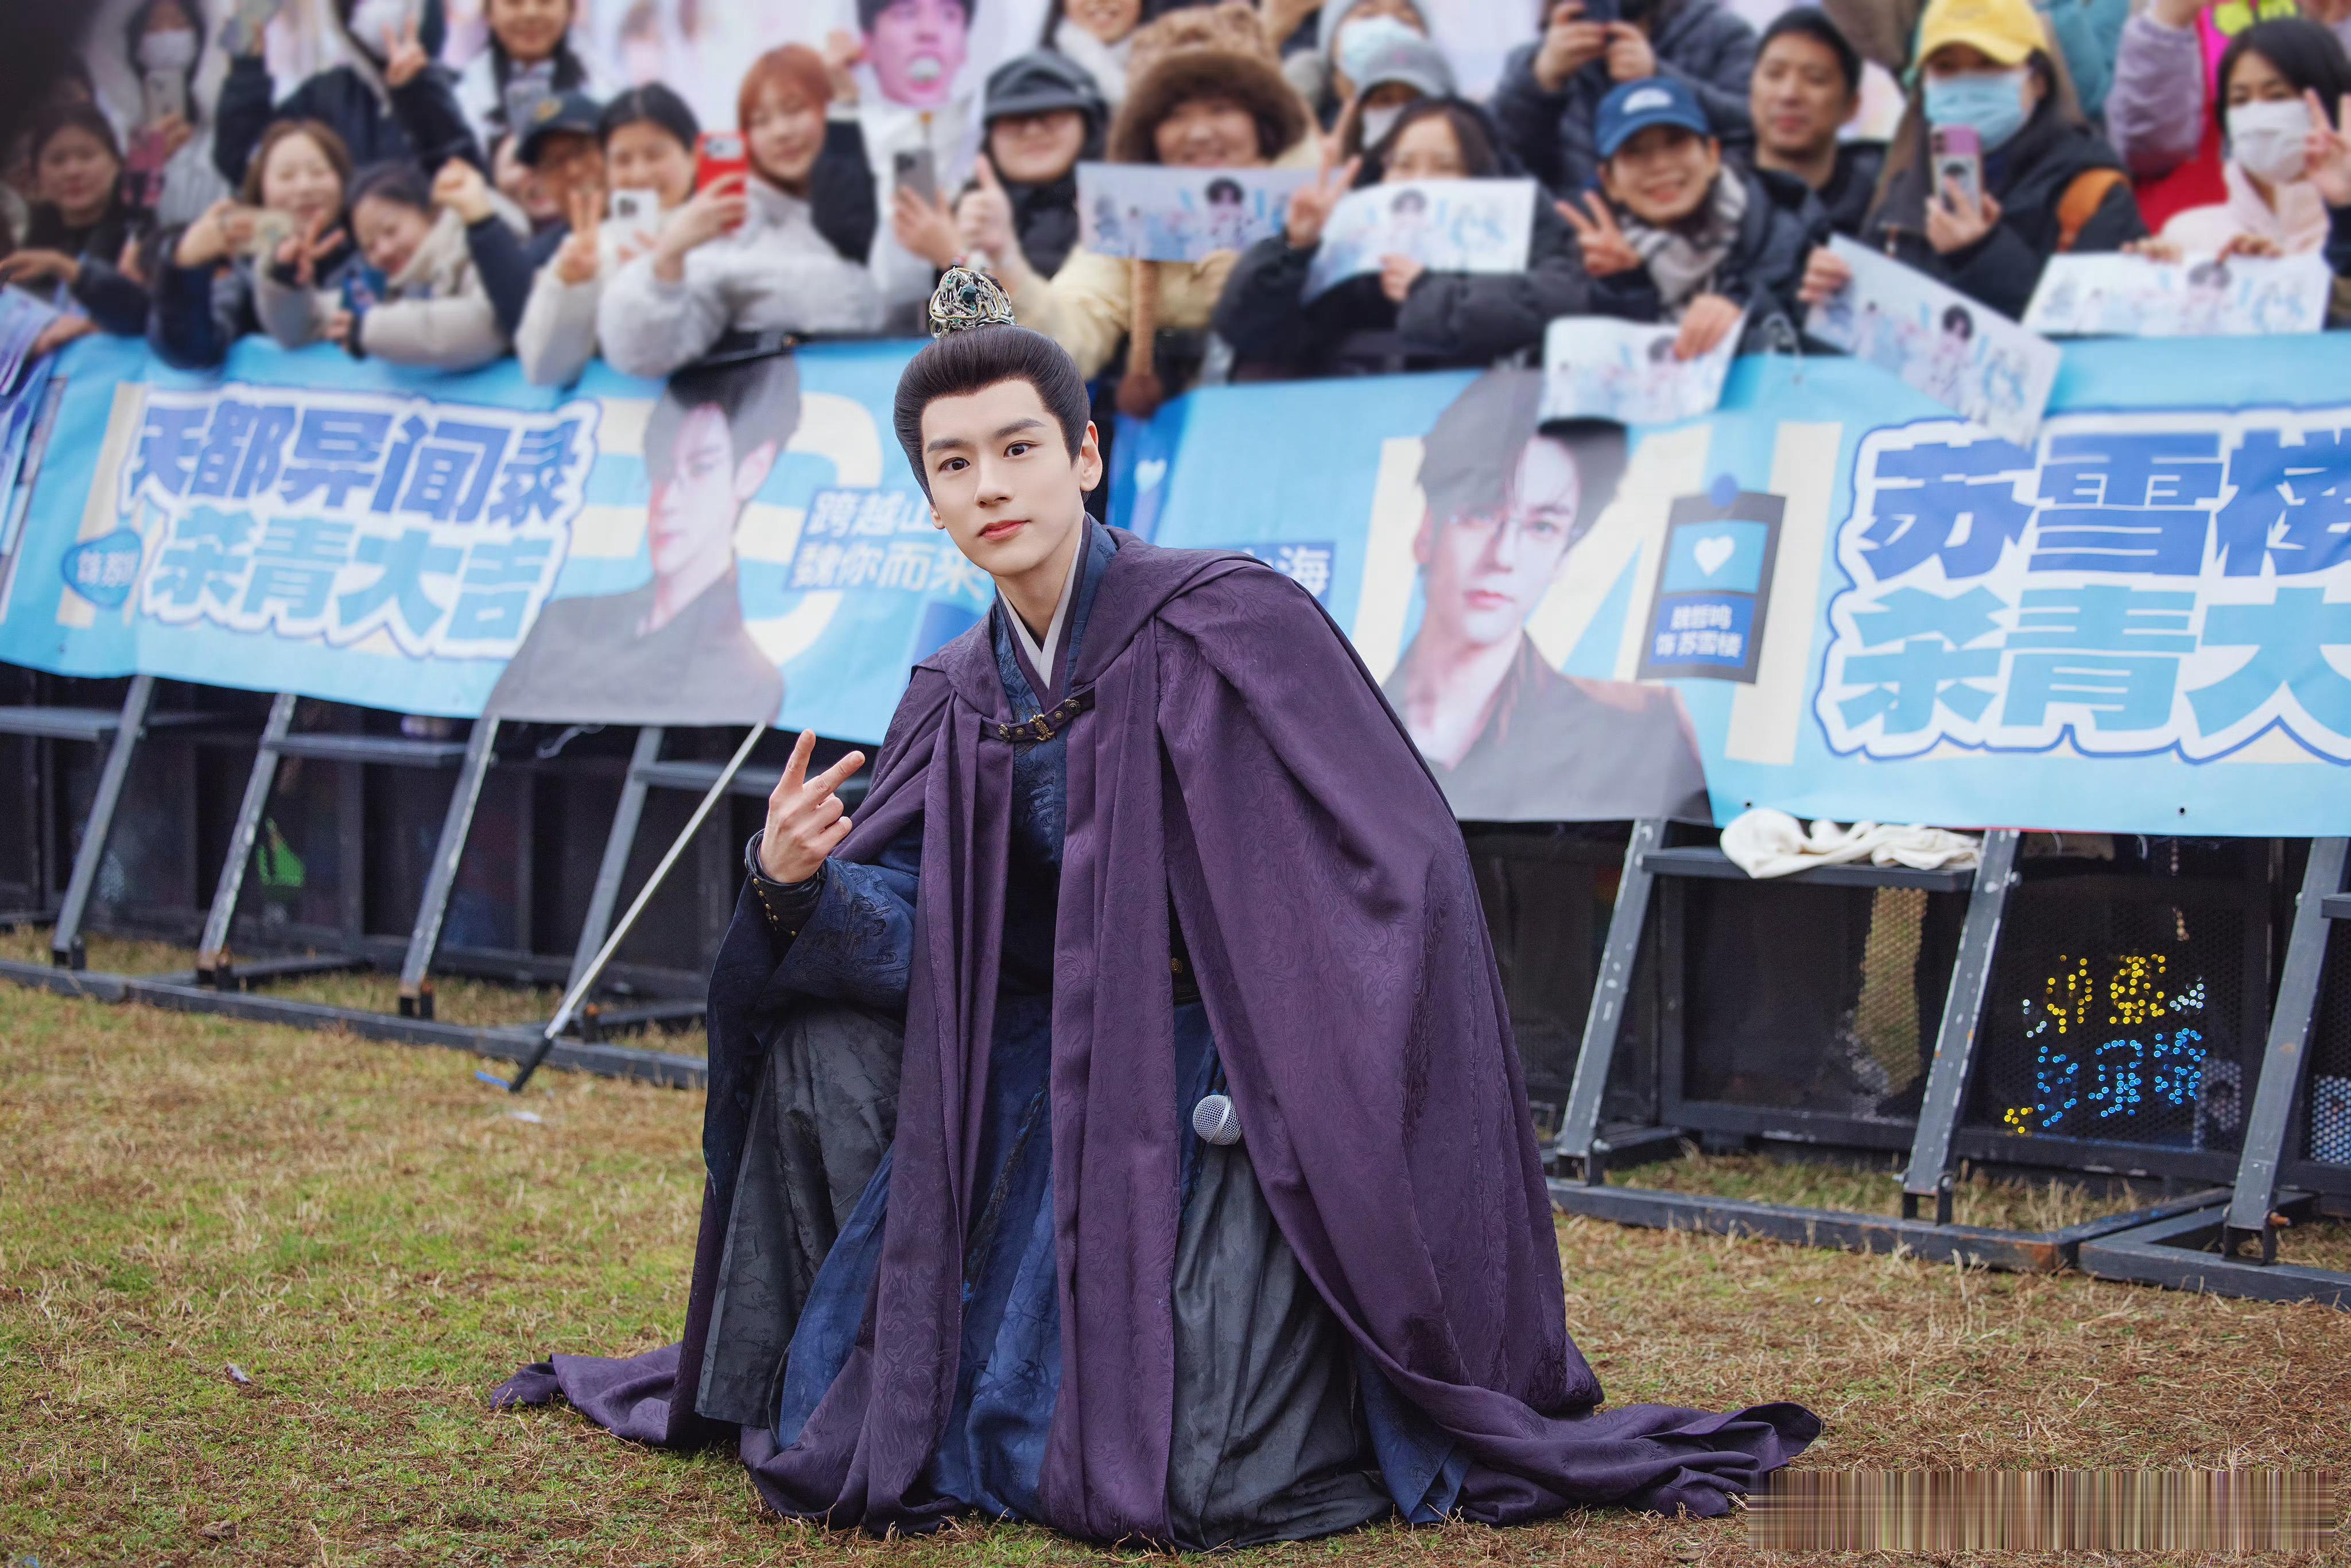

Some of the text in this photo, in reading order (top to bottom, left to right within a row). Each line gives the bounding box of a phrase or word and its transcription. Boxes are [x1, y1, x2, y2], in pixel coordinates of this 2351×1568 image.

[131, 399, 580, 527] 天都异闻录
[1856, 428, 2351, 581] 苏雪楼
[152, 504, 557, 641] 杀青大吉
[1836, 584, 2351, 740] 杀青大
